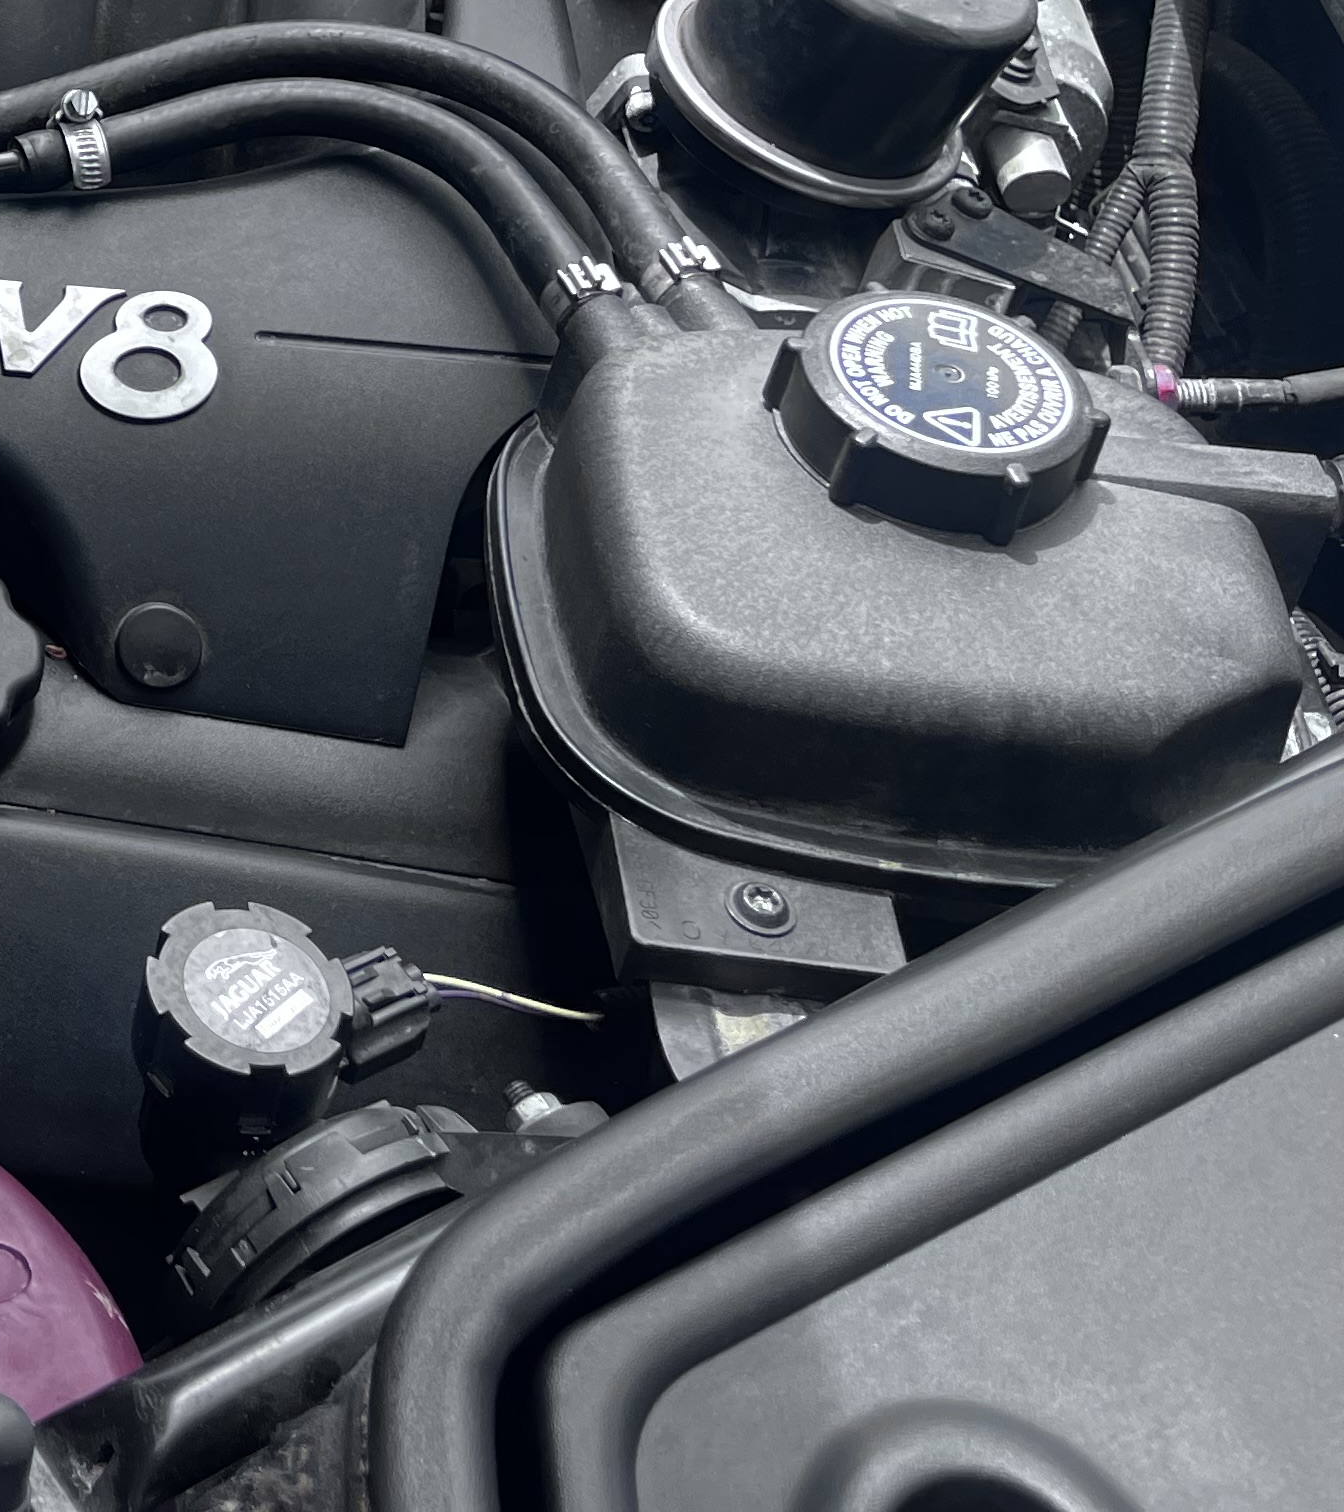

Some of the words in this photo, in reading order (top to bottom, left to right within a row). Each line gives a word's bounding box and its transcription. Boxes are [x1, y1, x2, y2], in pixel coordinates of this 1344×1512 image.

[843, 313, 883, 345] WHEN
[875, 305, 913, 323] HOT
[841, 342, 867, 378] OPEN
[863, 330, 895, 388] WARNING
[987, 325, 1046, 365] CHAUD
[851, 379, 891, 407] NOT
[986, 342, 1040, 430] AVERTISSEMENT
[1036, 378, 1064, 424] OUVRIR
[883, 404, 916, 425] DO
[1012, 419, 1049, 442] PAS
[987, 430, 1019, 447] NE
[210, 959, 282, 1021] JAGUAR
